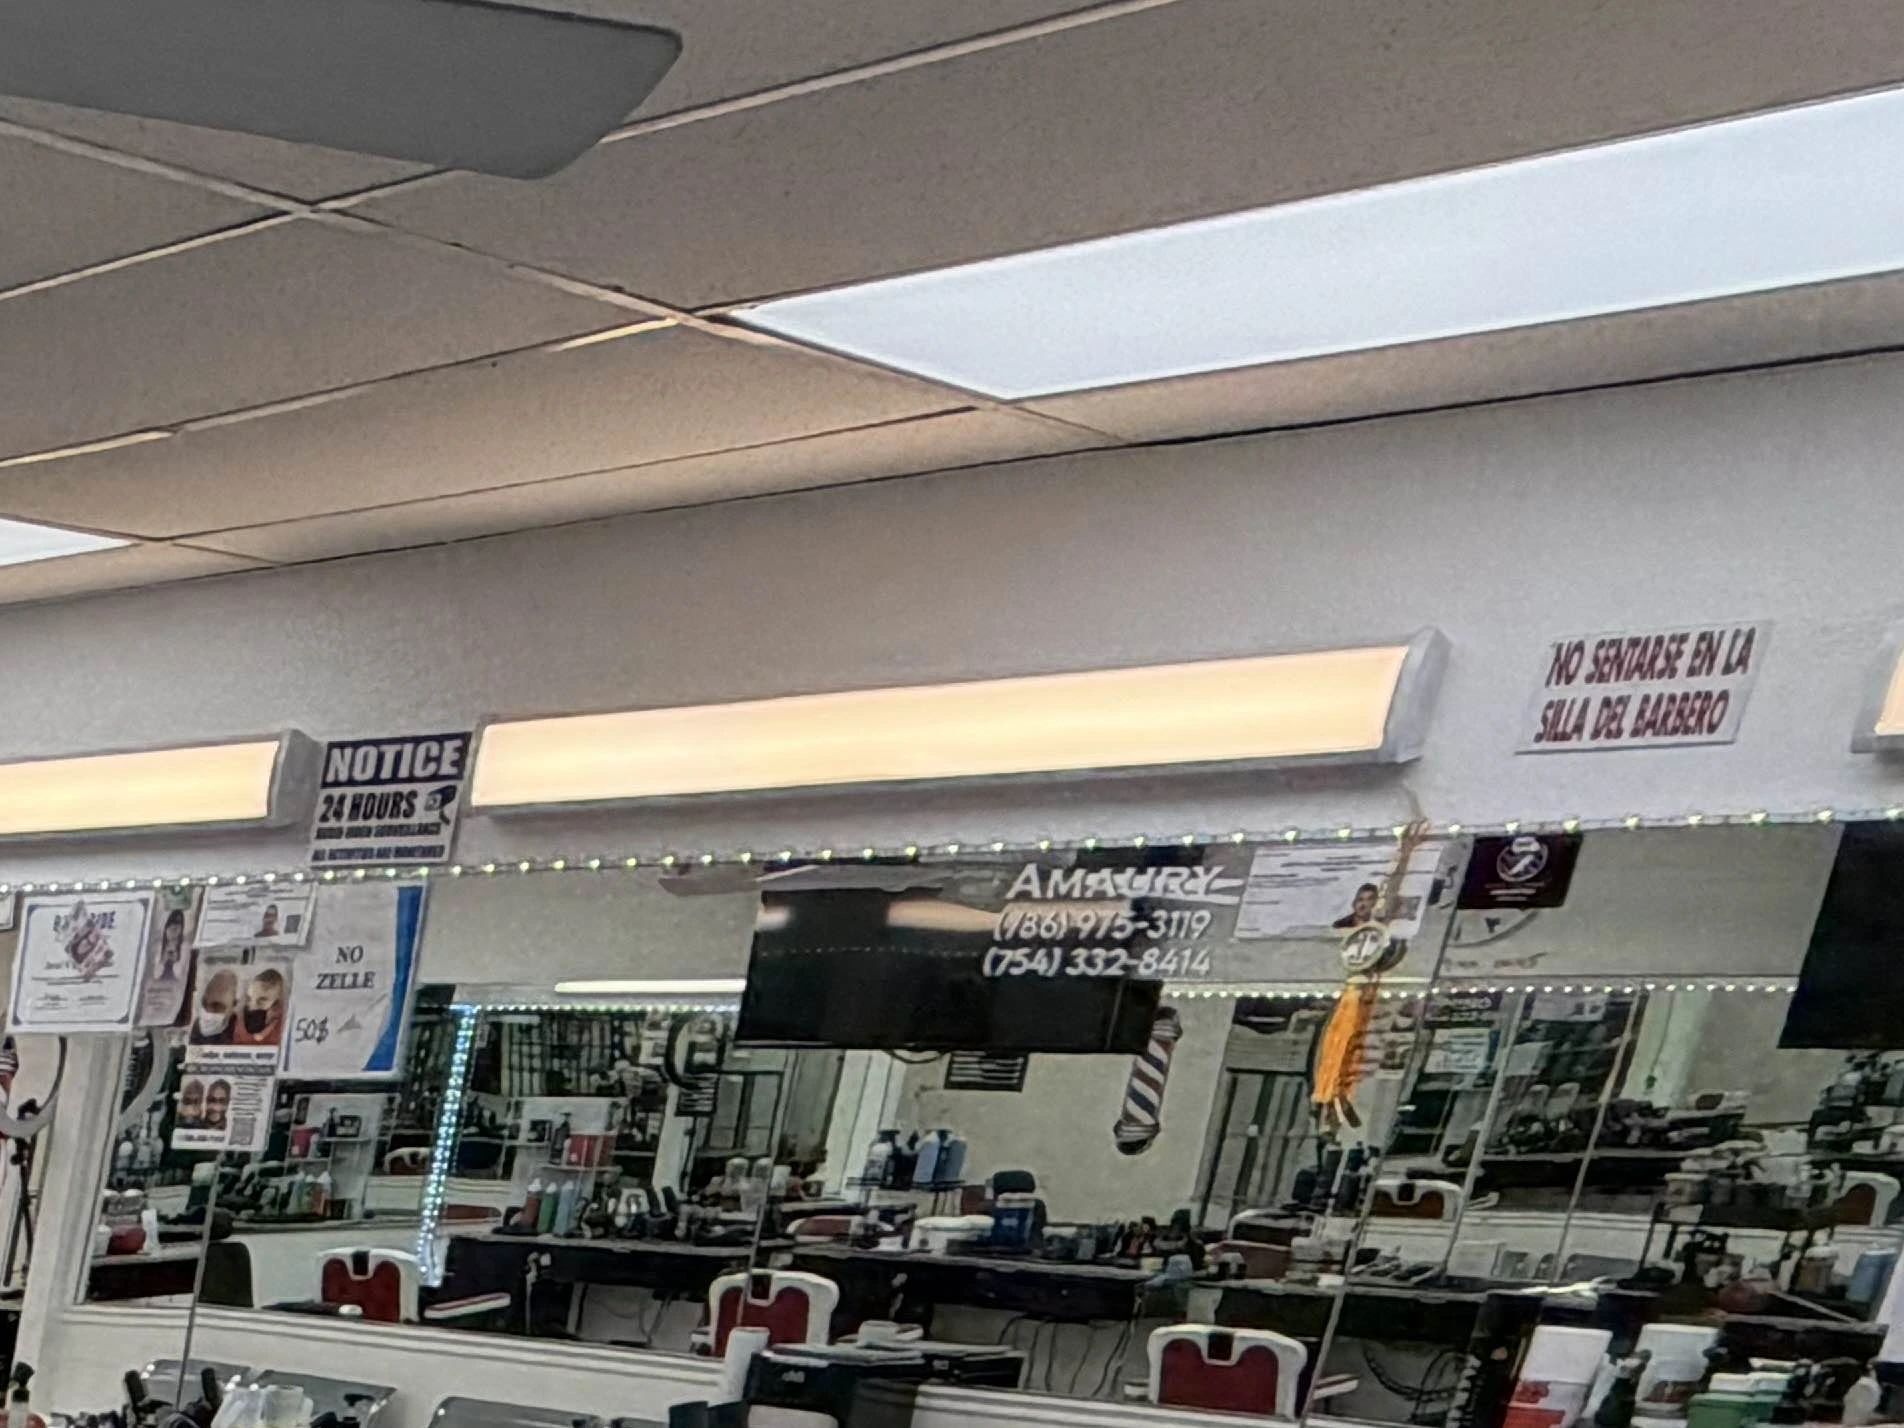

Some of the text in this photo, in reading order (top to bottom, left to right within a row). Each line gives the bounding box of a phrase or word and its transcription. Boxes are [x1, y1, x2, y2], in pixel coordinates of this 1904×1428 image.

[1545, 627, 1756, 688] NO SENTARSE EN LA
[1533, 689, 1729, 743] SILLA DEL BARBERO
[325, 739, 463, 783] NOTICE
[319, 790, 418, 823] 24 HOURS
[1006, 863, 1225, 900] AMAURY
[992, 909, 1212, 942] (786) 975-3119
[335, 945, 364, 964] NO
[982, 946, 1211, 978] (754) 332-8414
[315, 972, 376, 990] ZELLE
[295, 1016, 329, 1044] 50$
